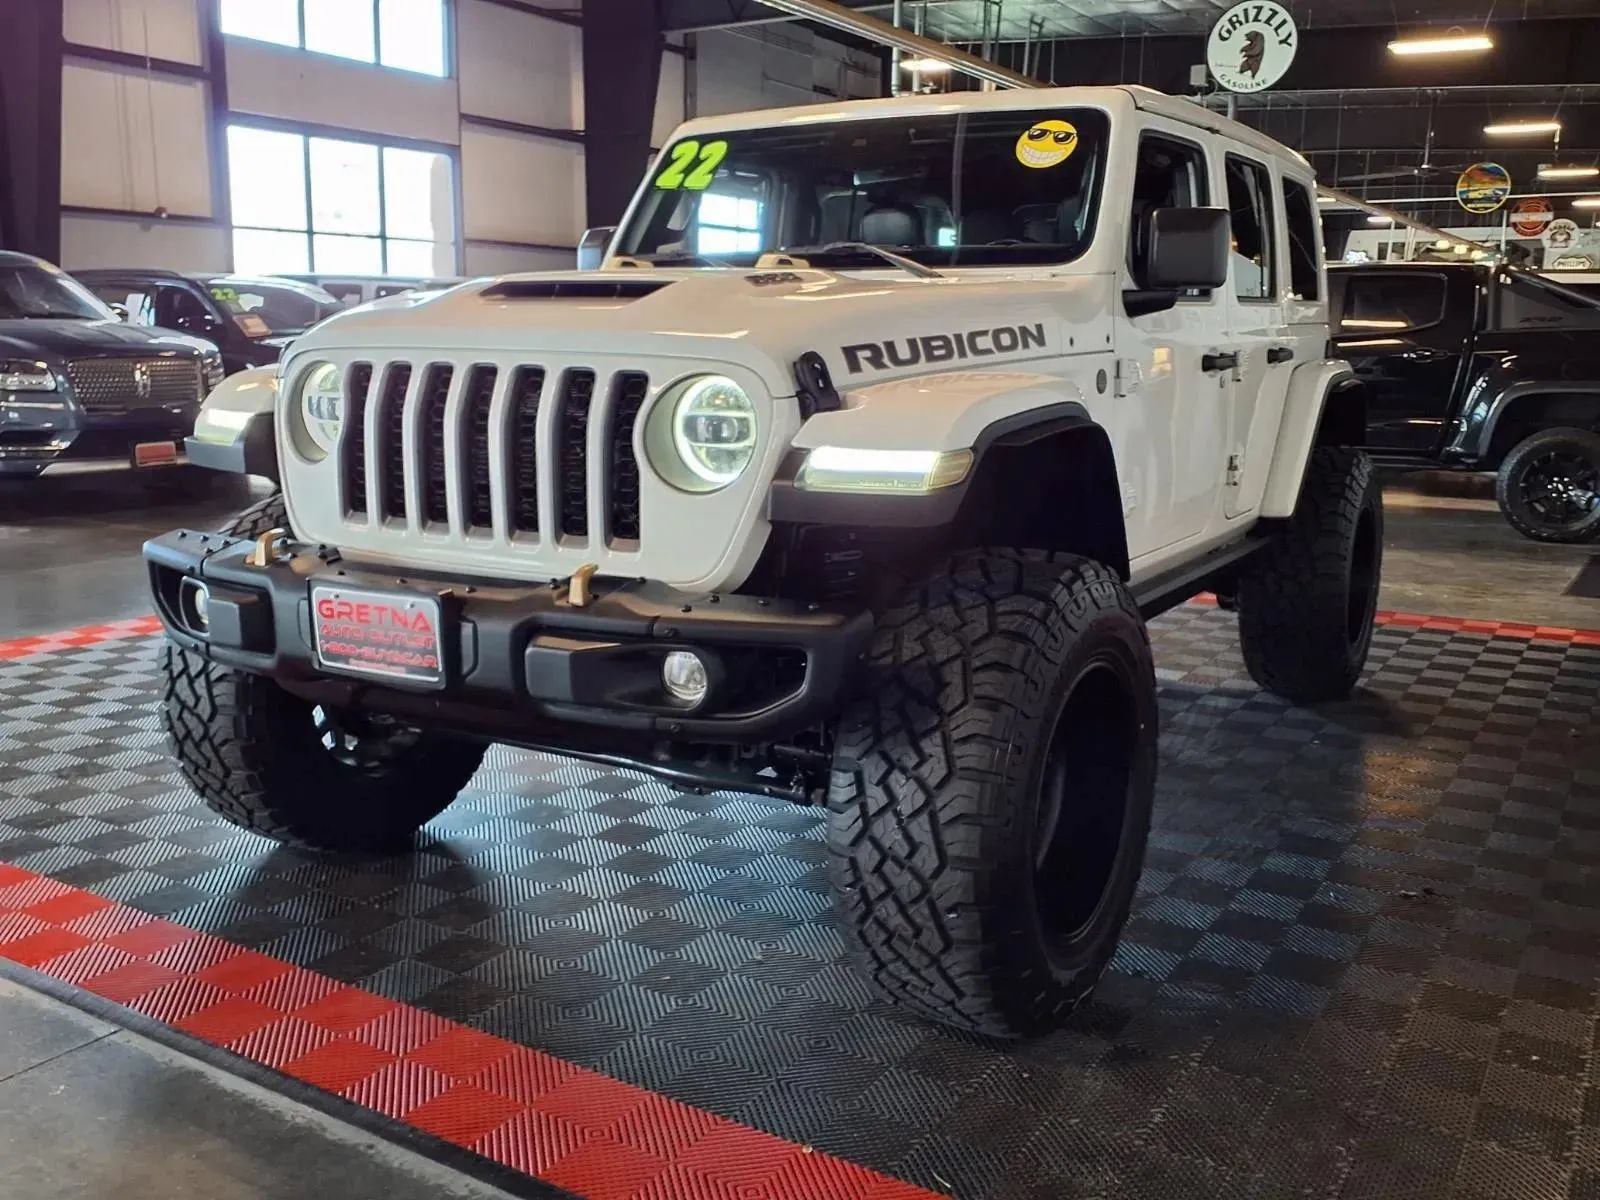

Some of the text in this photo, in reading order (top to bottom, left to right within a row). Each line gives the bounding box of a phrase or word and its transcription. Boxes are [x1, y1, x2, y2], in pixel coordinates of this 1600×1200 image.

[1218, 6, 1292, 47] GRIZZLY
[1220, 74, 1267, 89] GASOLINE
[655, 140, 728, 190] 22
[840, 323, 1047, 375] RUBICON
[318, 599, 432, 632] GRETNA
